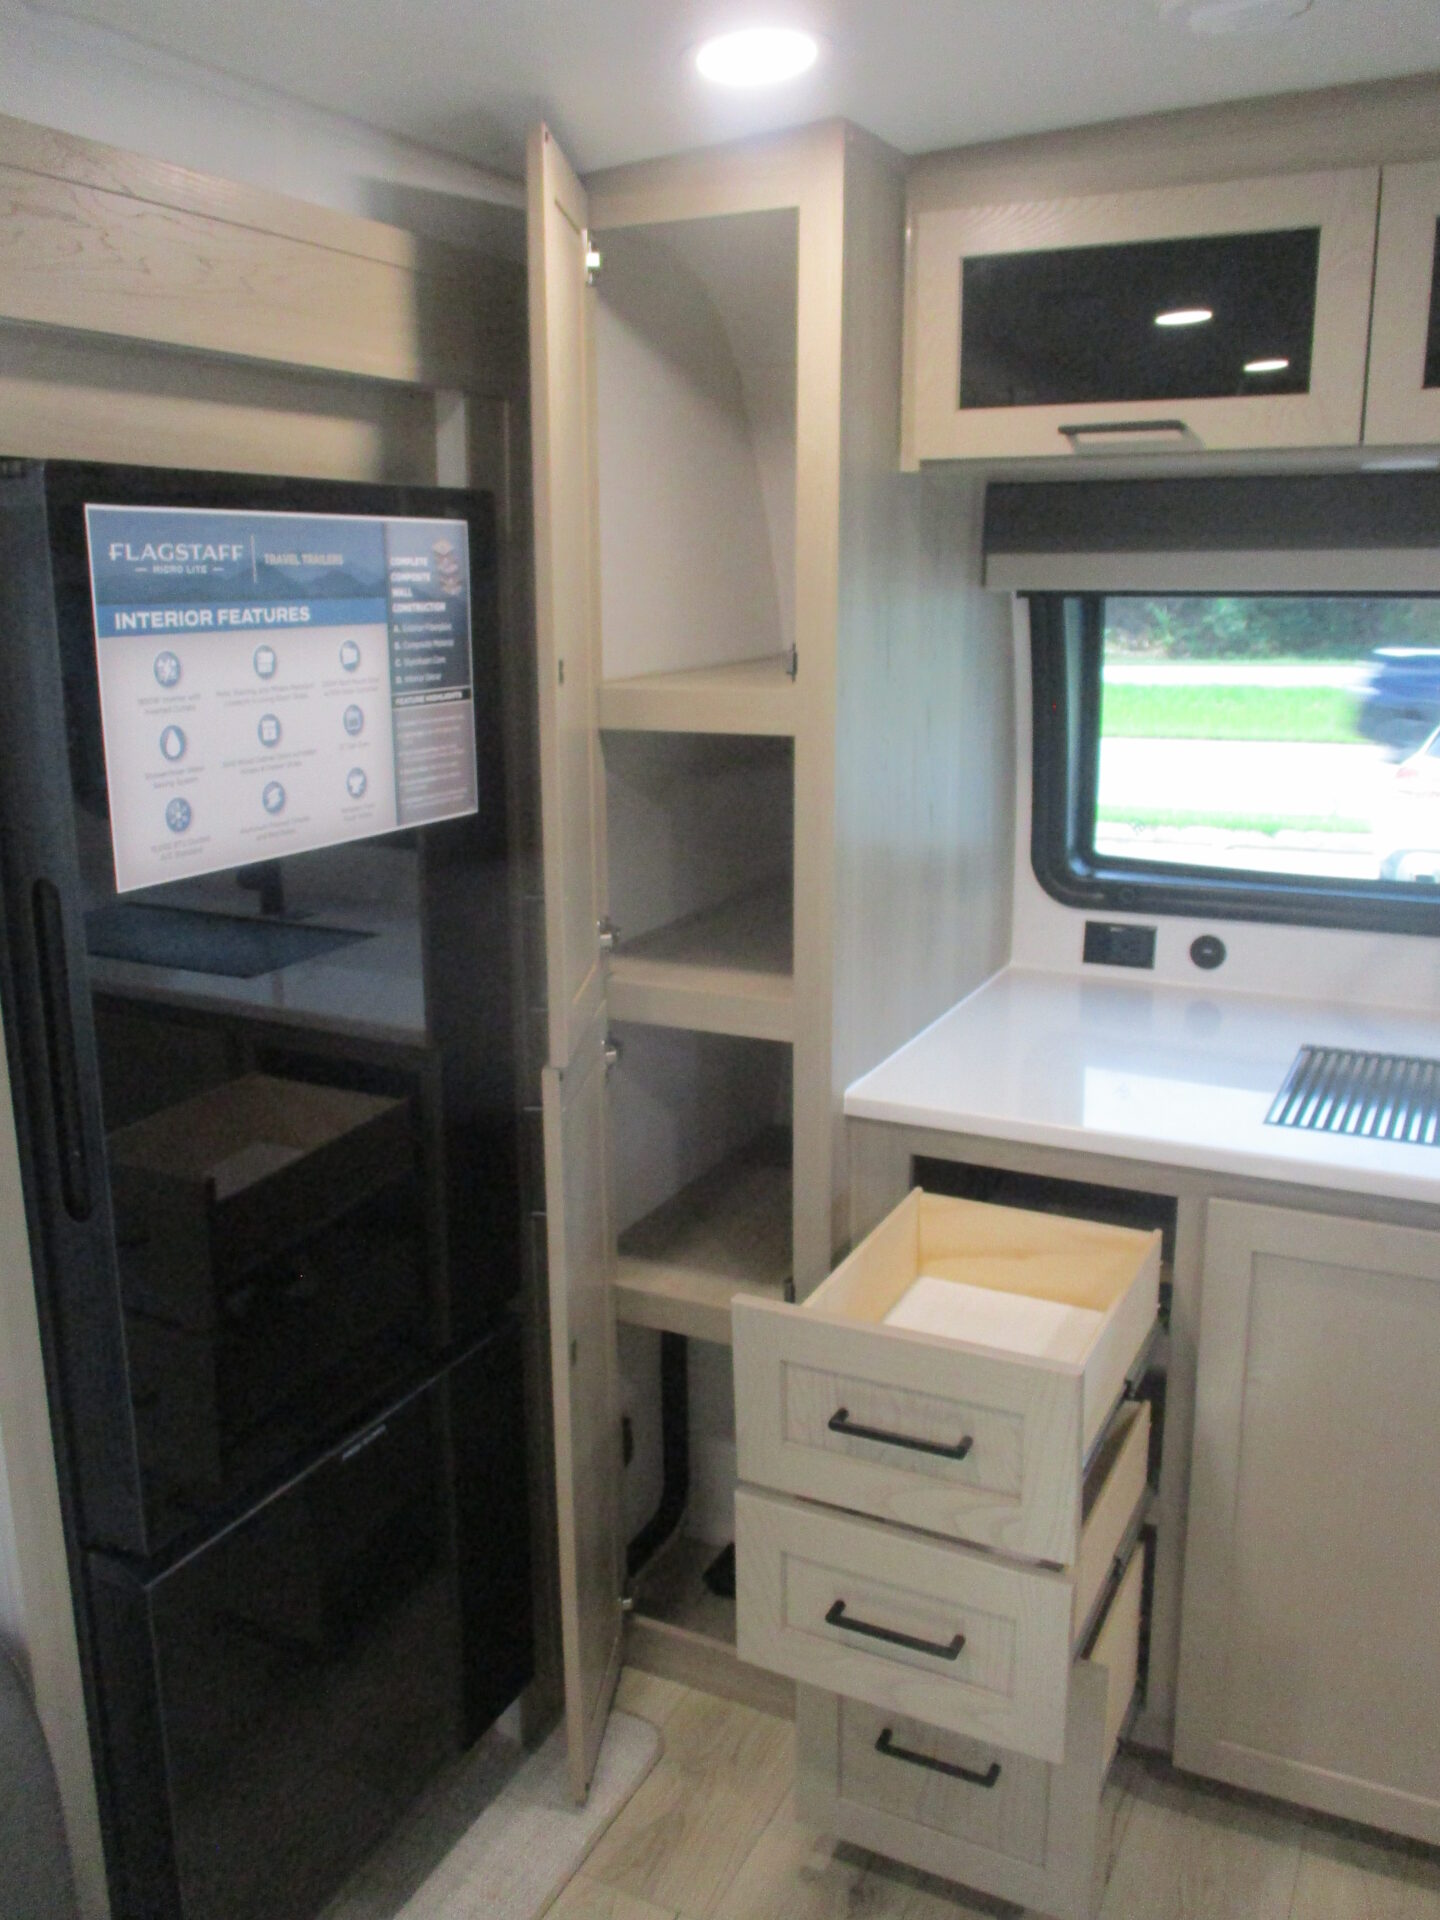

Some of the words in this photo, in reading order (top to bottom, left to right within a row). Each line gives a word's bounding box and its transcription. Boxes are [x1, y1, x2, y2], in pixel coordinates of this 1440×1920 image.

[109, 543, 243, 562] FLAGSTAFF
[264, 553, 300, 566] TRAVEL
[186, 564, 208, 574] LITE
[114, 609, 213, 630] INTERIOR
[217, 606, 311, 625] FEATURES
